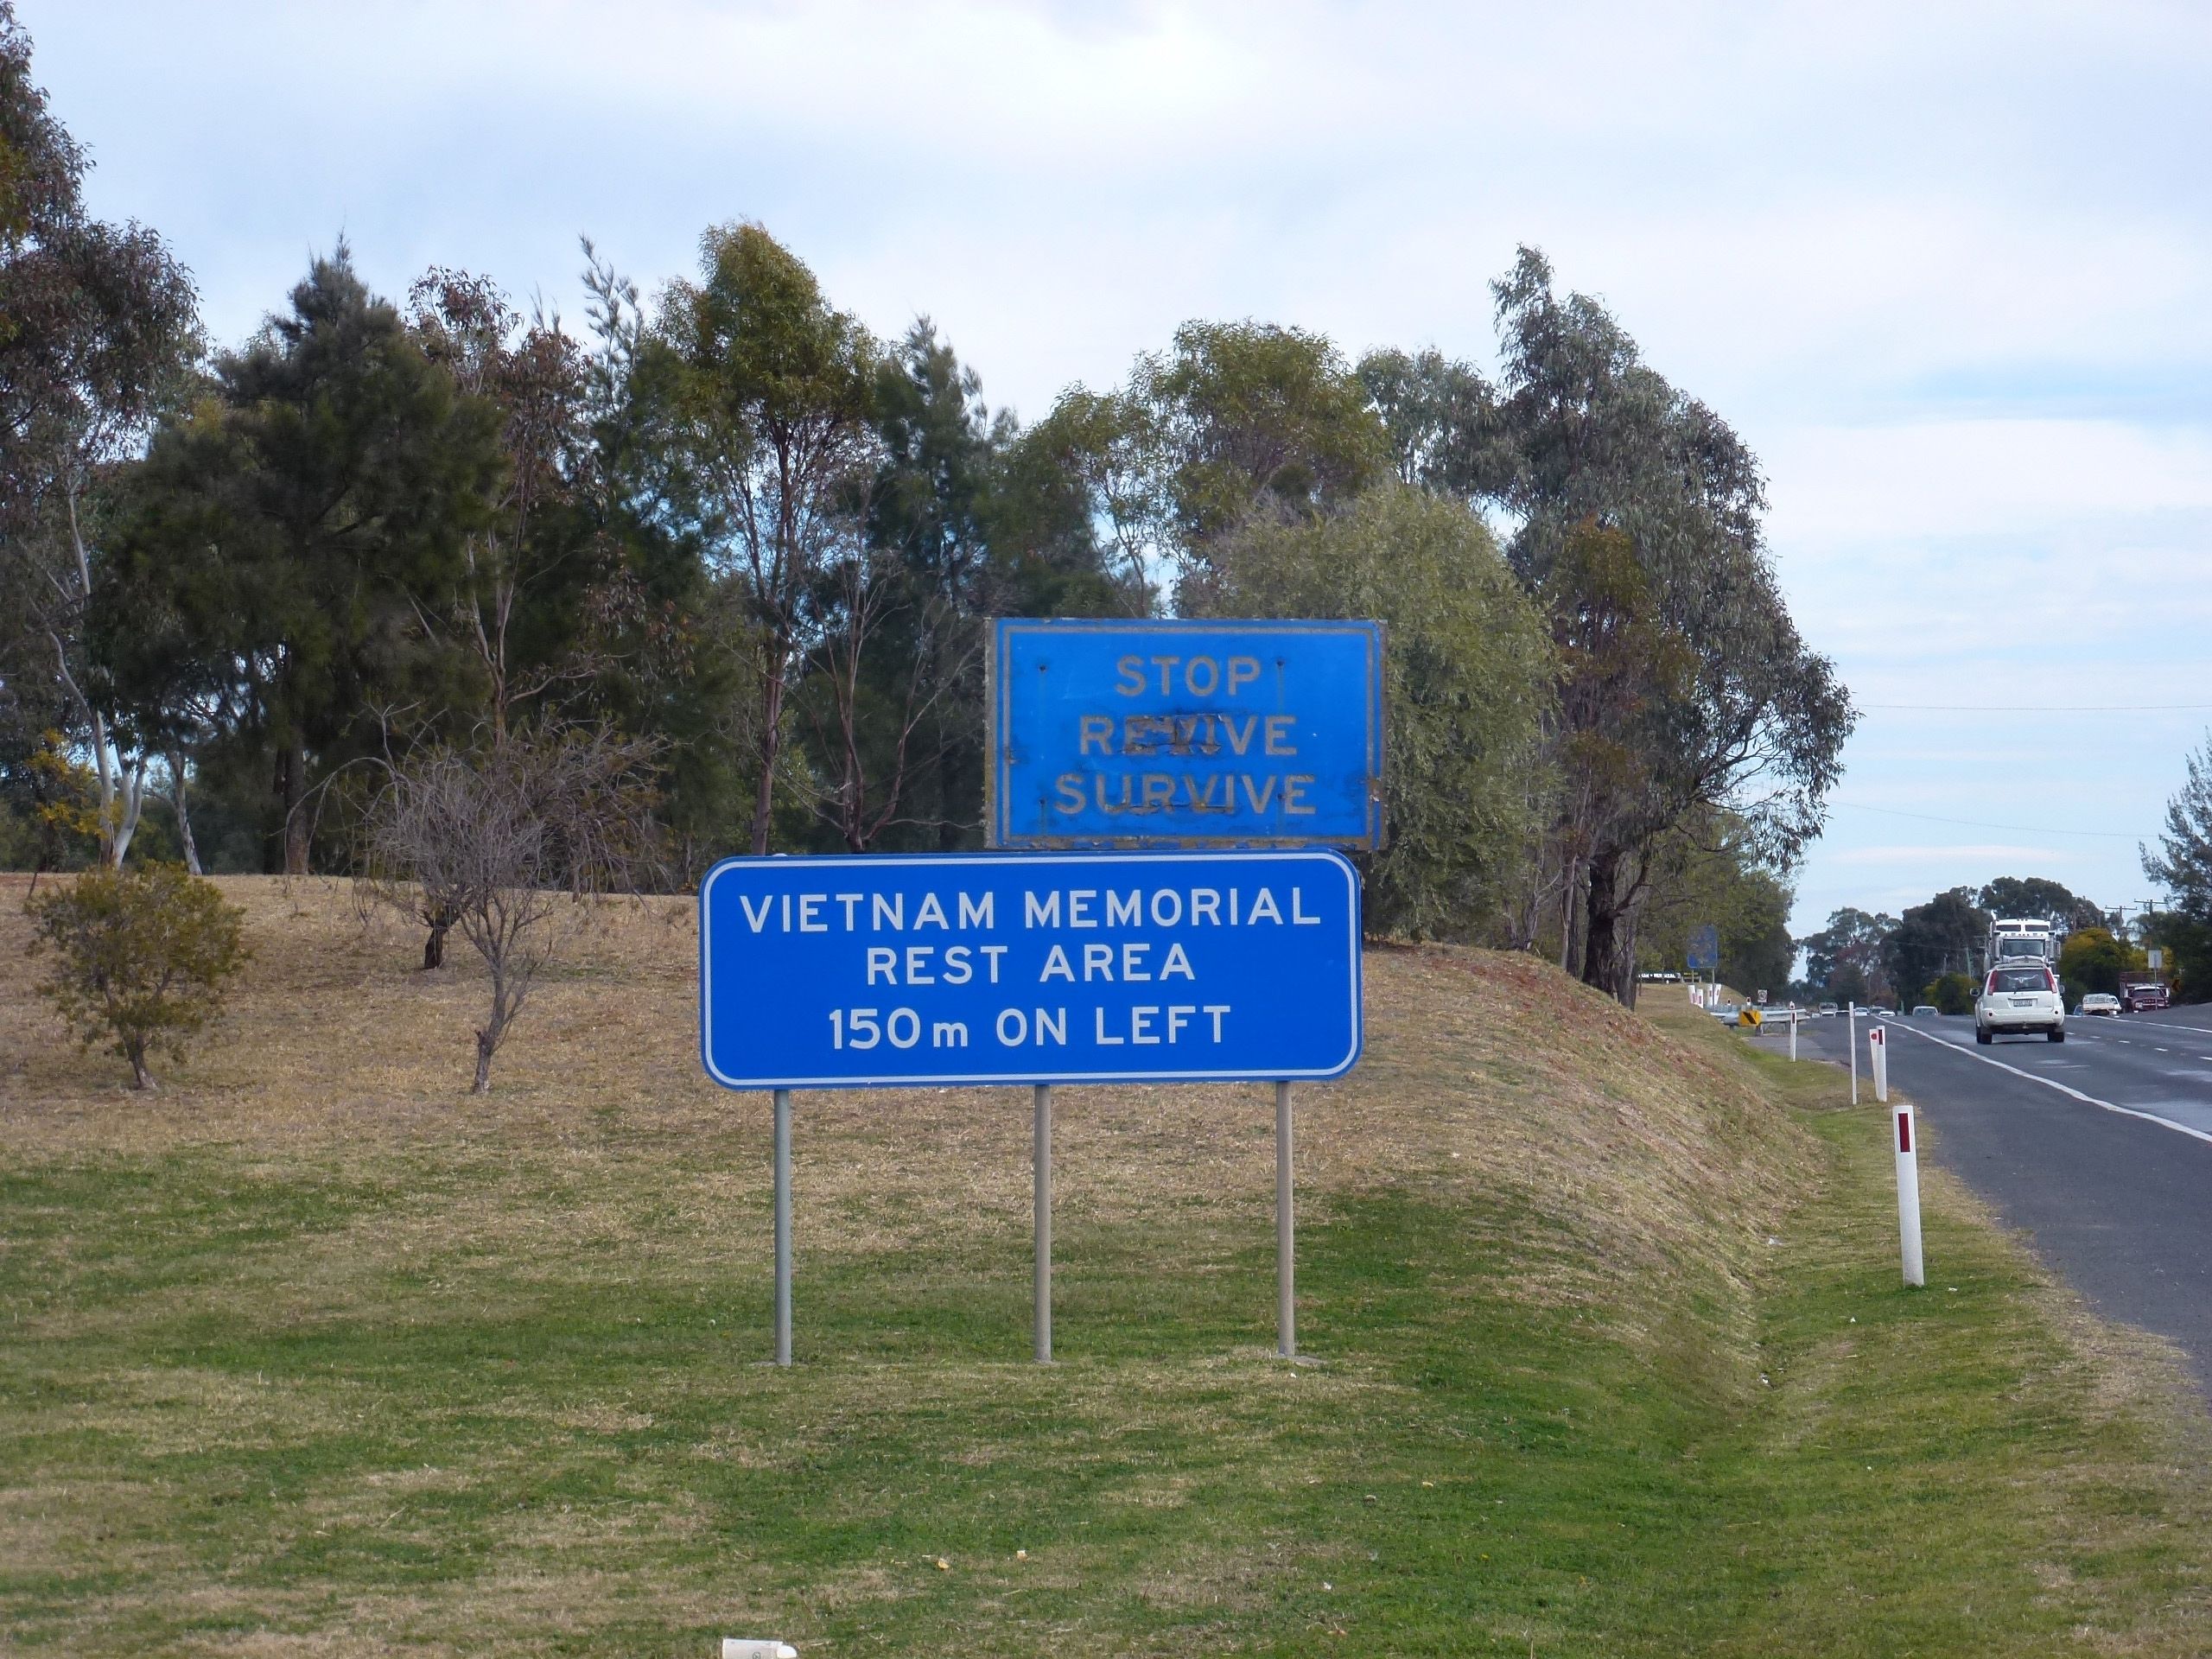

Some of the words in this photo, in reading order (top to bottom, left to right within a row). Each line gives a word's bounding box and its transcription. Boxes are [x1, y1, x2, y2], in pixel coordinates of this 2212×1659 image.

[1116, 655, 1261, 696] STOP
[1079, 715, 1298, 754] REVIVE
[1054, 774, 1316, 814] SURVIVE
[740, 893, 994, 933] VIETNAM
[1025, 888, 1321, 929] MEMORIAL
[867, 946, 1008, 985] REST
[1039, 944, 1195, 982] AREA
[996, 1007, 1066, 1047] ON
[1096, 1006, 1230, 1045] LEFT
